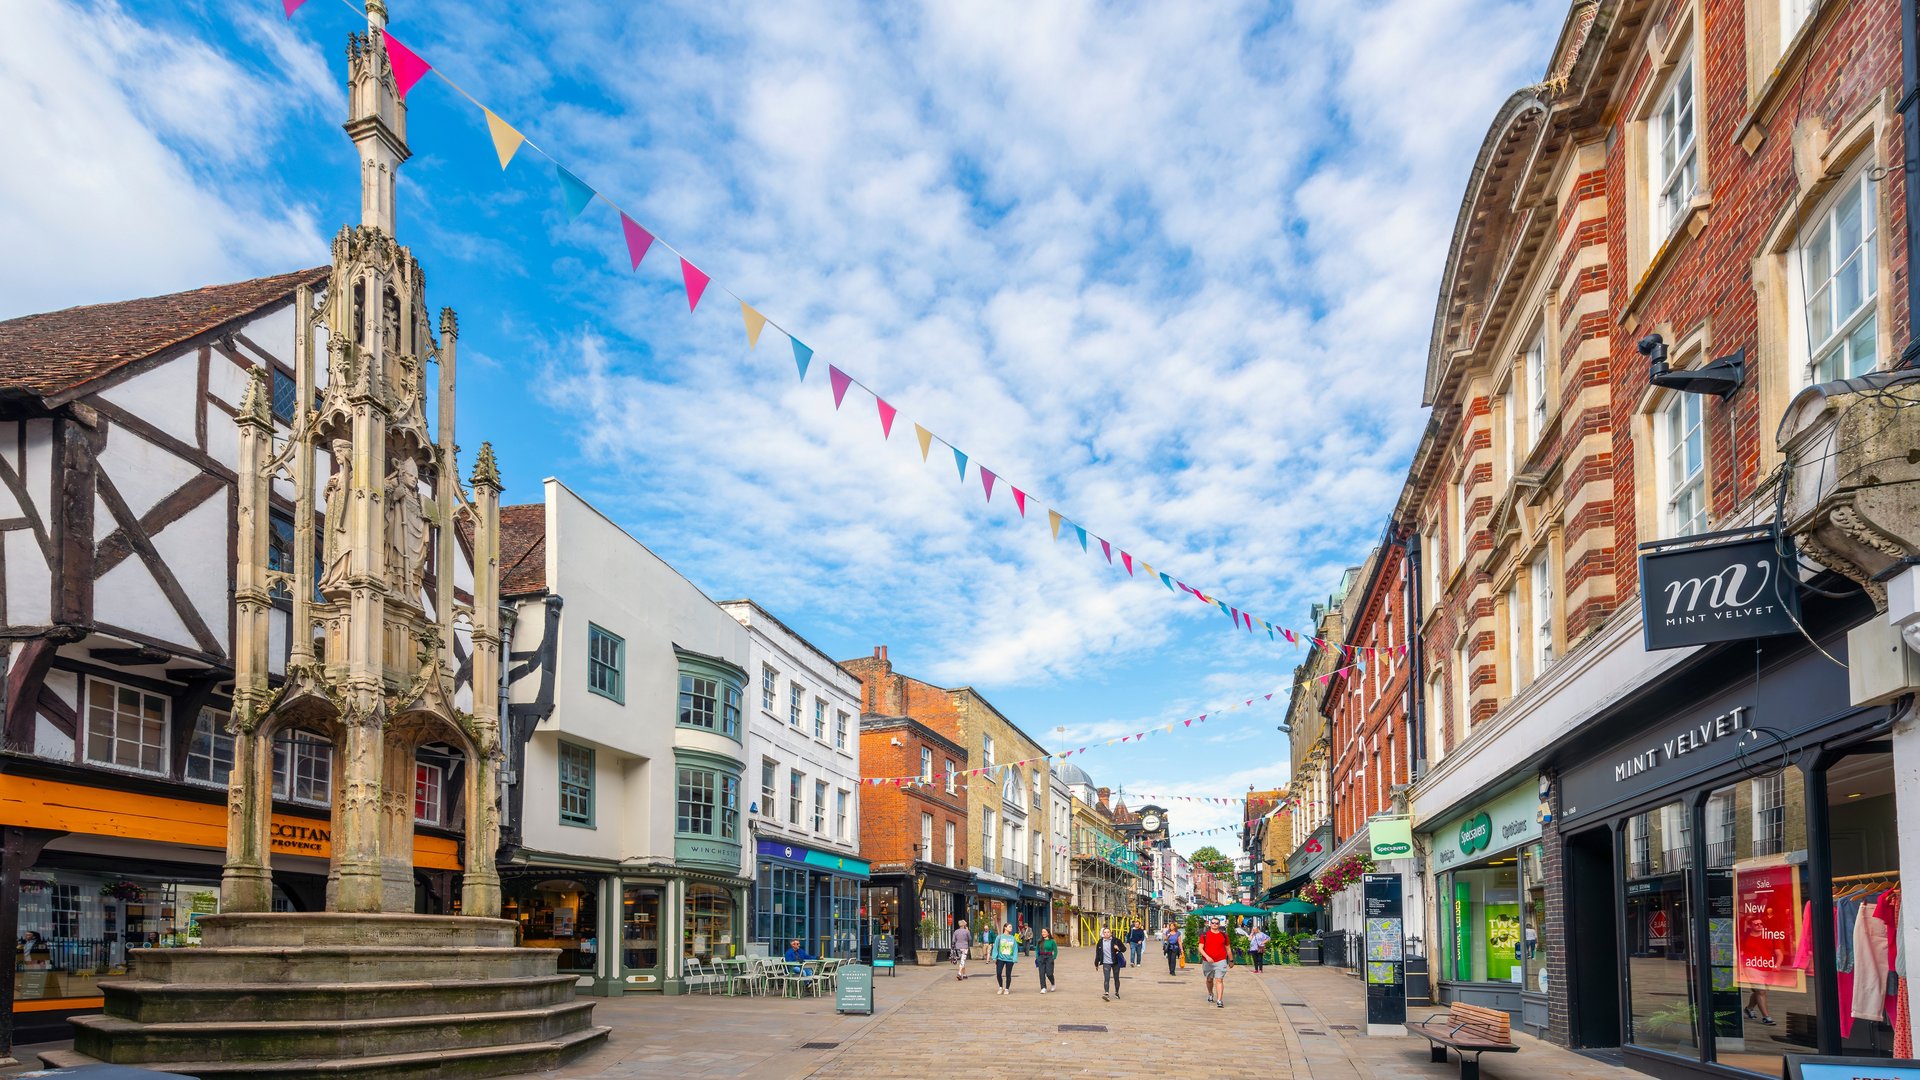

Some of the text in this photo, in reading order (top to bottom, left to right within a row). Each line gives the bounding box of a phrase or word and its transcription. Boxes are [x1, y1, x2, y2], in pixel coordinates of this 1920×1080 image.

[1666, 605, 1774, 627] MINT VELVET
[1615, 706, 1743, 782] MINT VELVET
[1460, 824, 1486, 845] Specsavers
[1502, 819, 1527, 840] Opticians
[271, 839, 322, 850] PROVENCE
[1376, 845, 1408, 853] Specsavers
[1756, 879, 1772, 889] Sale.
[1744, 902, 1766, 914] New
[1761, 928, 1785, 940] lines
[1745, 956, 1777, 969] added.
